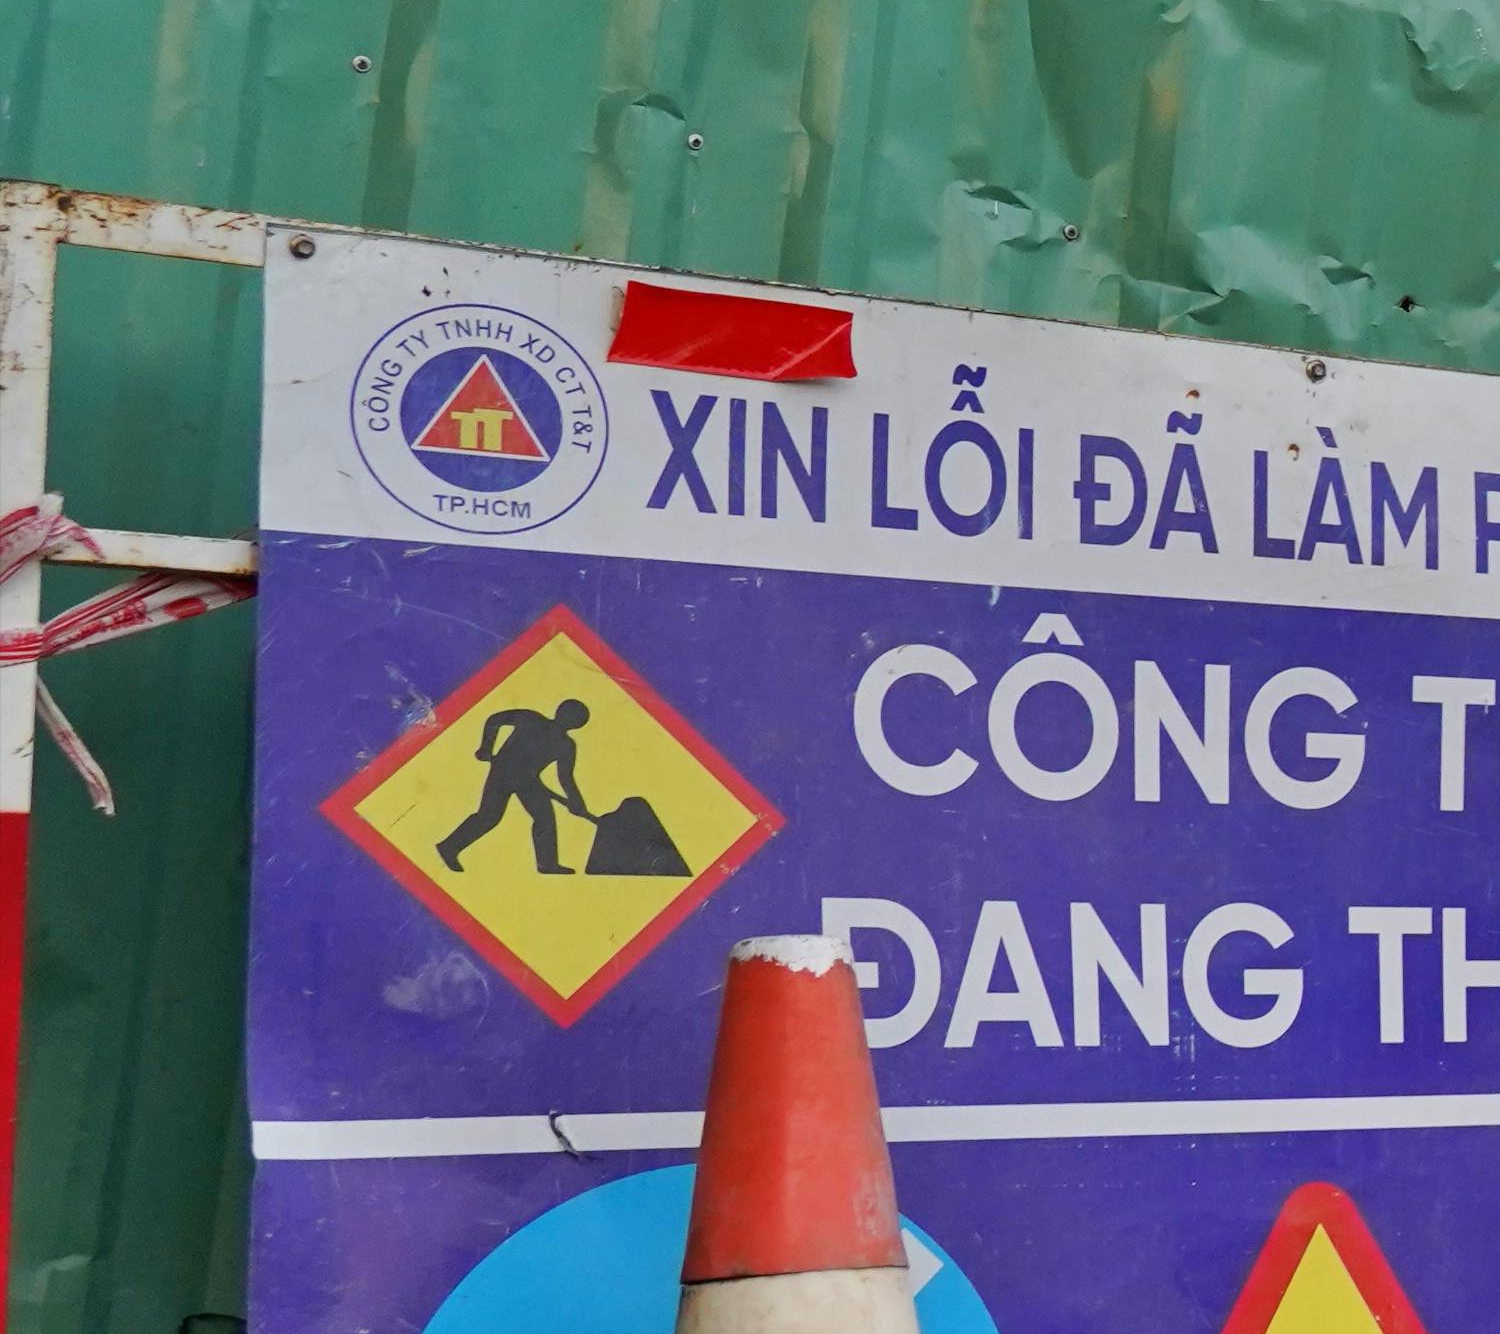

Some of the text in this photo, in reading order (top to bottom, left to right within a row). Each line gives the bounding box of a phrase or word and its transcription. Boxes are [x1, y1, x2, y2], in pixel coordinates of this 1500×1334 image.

[361, 319, 595, 455] CÔNG TY TNHH XD CT T&T
[433, 494, 532, 519] TP.HCM
[646, 389, 828, 523] XIN
[872, 364, 1034, 540] LỖI
[1073, 410, 1219, 555] ĐÃ
[1252, 426, 1439, 571] LÀM
[853, 612, 1366, 810] CÔNG
[822, 897, 1304, 1049] ĐANG
